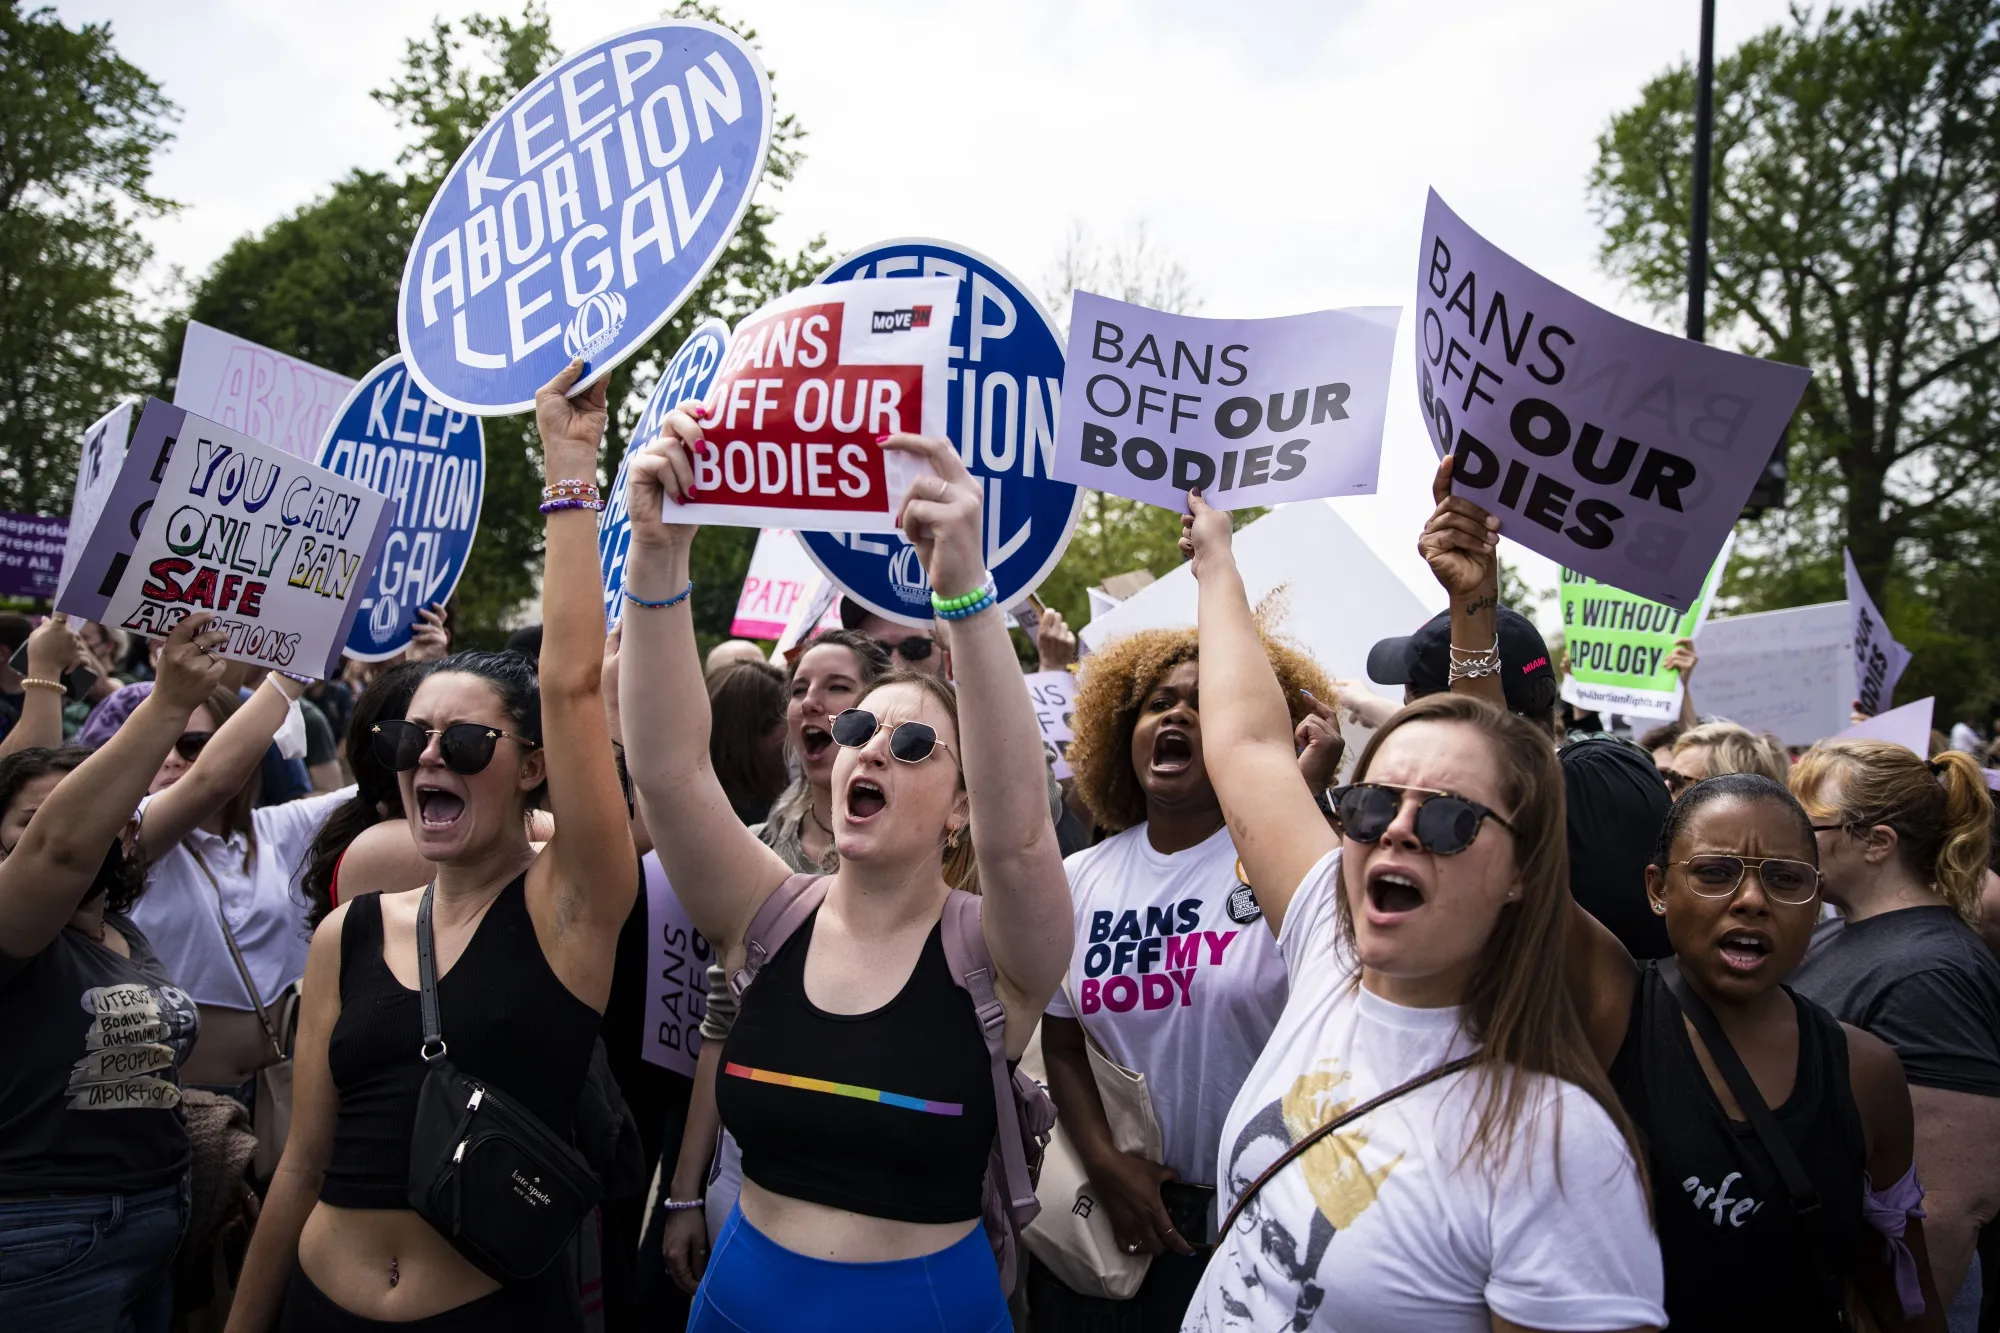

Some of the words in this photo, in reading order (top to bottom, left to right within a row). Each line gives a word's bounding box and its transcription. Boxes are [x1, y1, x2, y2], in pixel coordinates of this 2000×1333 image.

[465, 39, 664, 212] KEEP
[420, 51, 742, 329] ABORTION
[453, 165, 724, 369] LEGAL
[564, 291, 627, 358] NOW
[1428, 235, 1576, 386] BANS
[723, 314, 830, 377] BANS
[1092, 320, 1249, 387] BANS
[211, 346, 354, 460] ABORT
[366, 370, 468, 450] KEEP
[643, 334, 719, 439] KEEP
[698, 378, 783, 430] OFF
[794, 378, 902, 434] OUR
[1085, 373, 1202, 434] OFF
[1214, 382, 1351, 440] OUR
[1424, 307, 1504, 413] OFF
[1509, 397, 1697, 514] OUR
[694, 440, 871, 498] BODIES
[1080, 421, 1311, 493] BODIES
[1422, 358, 1625, 551] BODIES
[189, 438, 281, 513] YOU
[281, 476, 361, 540] CAN
[166, 505, 292, 578] ONLY
[287, 536, 361, 600] BAN
[889, 546, 931, 591] NO
[141, 557, 268, 617] SAFE
[1565, 600, 1575, 625] &
[1582, 598, 1686, 635] WITHOUT
[121, 600, 301, 666] ABRTIONS
[1522, 656, 1547, 675] MIAMI
[1571, 639, 1663, 677] APOLOGY
[1088, 898, 1203, 944] BANS
[1232, 890, 1252, 900] STAND
[1233, 897, 1249, 906] WITH
[1234, 902, 1253, 912] BLACK
[658, 922, 687, 1052] BANS
[1084, 937, 1162, 978] OFF
[1164, 930, 1239, 971] MY
[1081, 967, 1198, 1015] BODY
[511, 1169, 529, 1188] kate
[527, 1185, 551, 1205] spade
